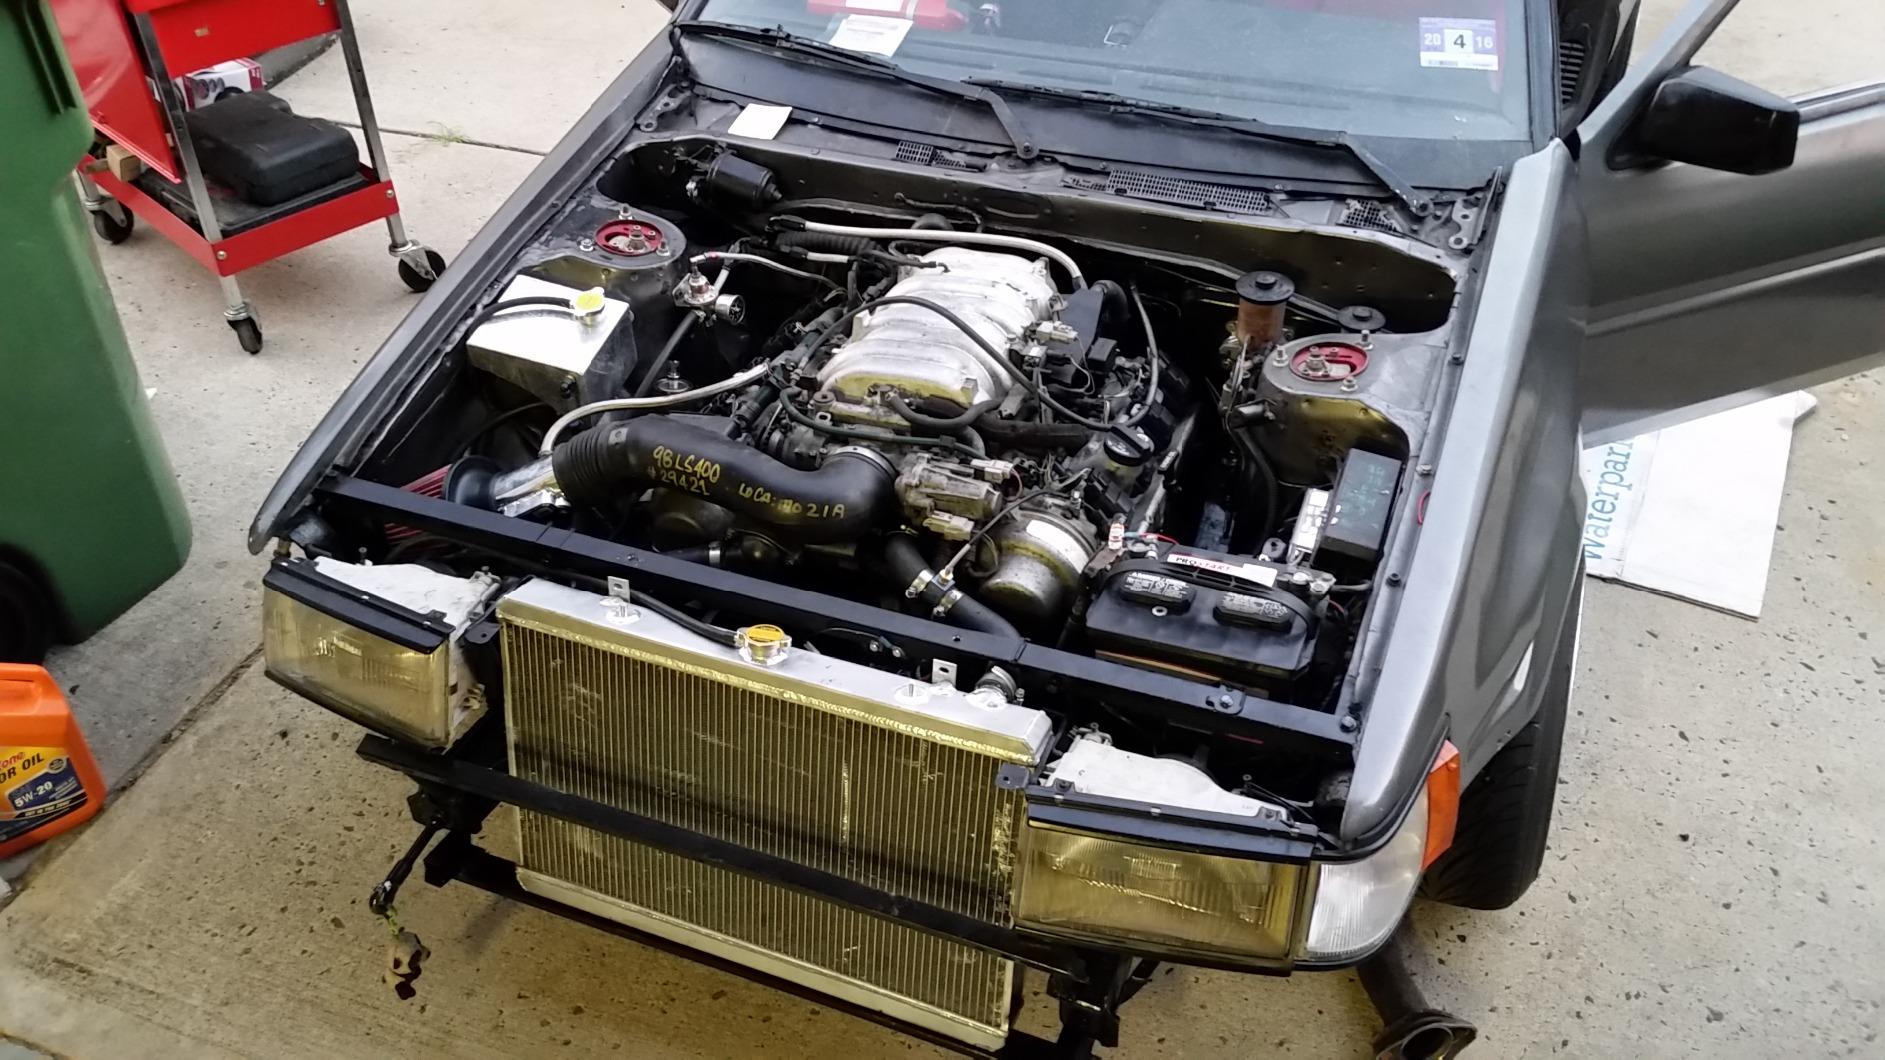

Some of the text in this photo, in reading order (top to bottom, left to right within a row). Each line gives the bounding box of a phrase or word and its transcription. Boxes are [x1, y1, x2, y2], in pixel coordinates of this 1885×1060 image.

[1423, 32, 1494, 49] 20 4 16
[22, 752, 45, 771] OIL
[14, 780, 53, 808] 5W-20
